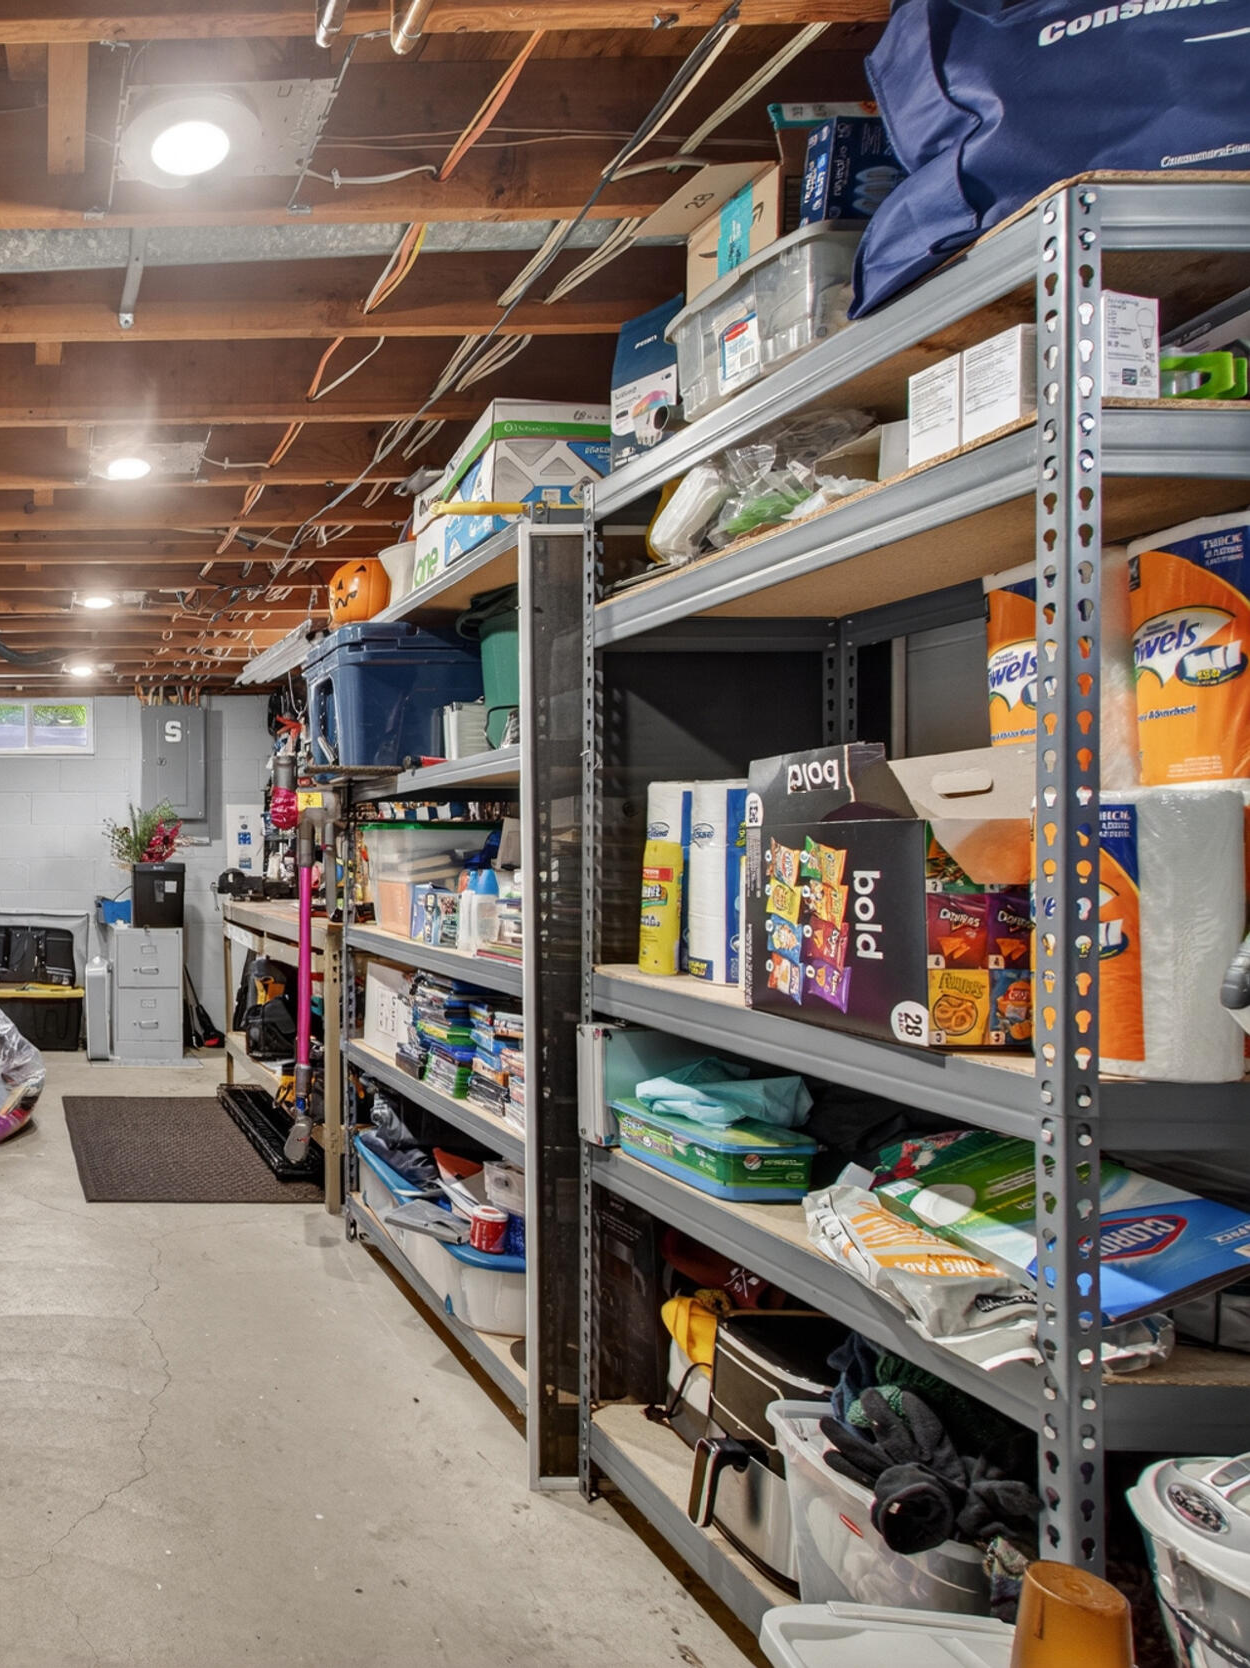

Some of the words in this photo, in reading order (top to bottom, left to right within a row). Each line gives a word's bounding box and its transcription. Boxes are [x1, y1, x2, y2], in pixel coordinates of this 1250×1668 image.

[1039, 0, 1221, 46] Consu
[164, 720, 182, 743] S
[787, 759, 839, 795] bold
[853, 870, 884, 960] bold
[904, 1012, 923, 1038] 28
[1100, 1218, 1177, 1256] CLORO
